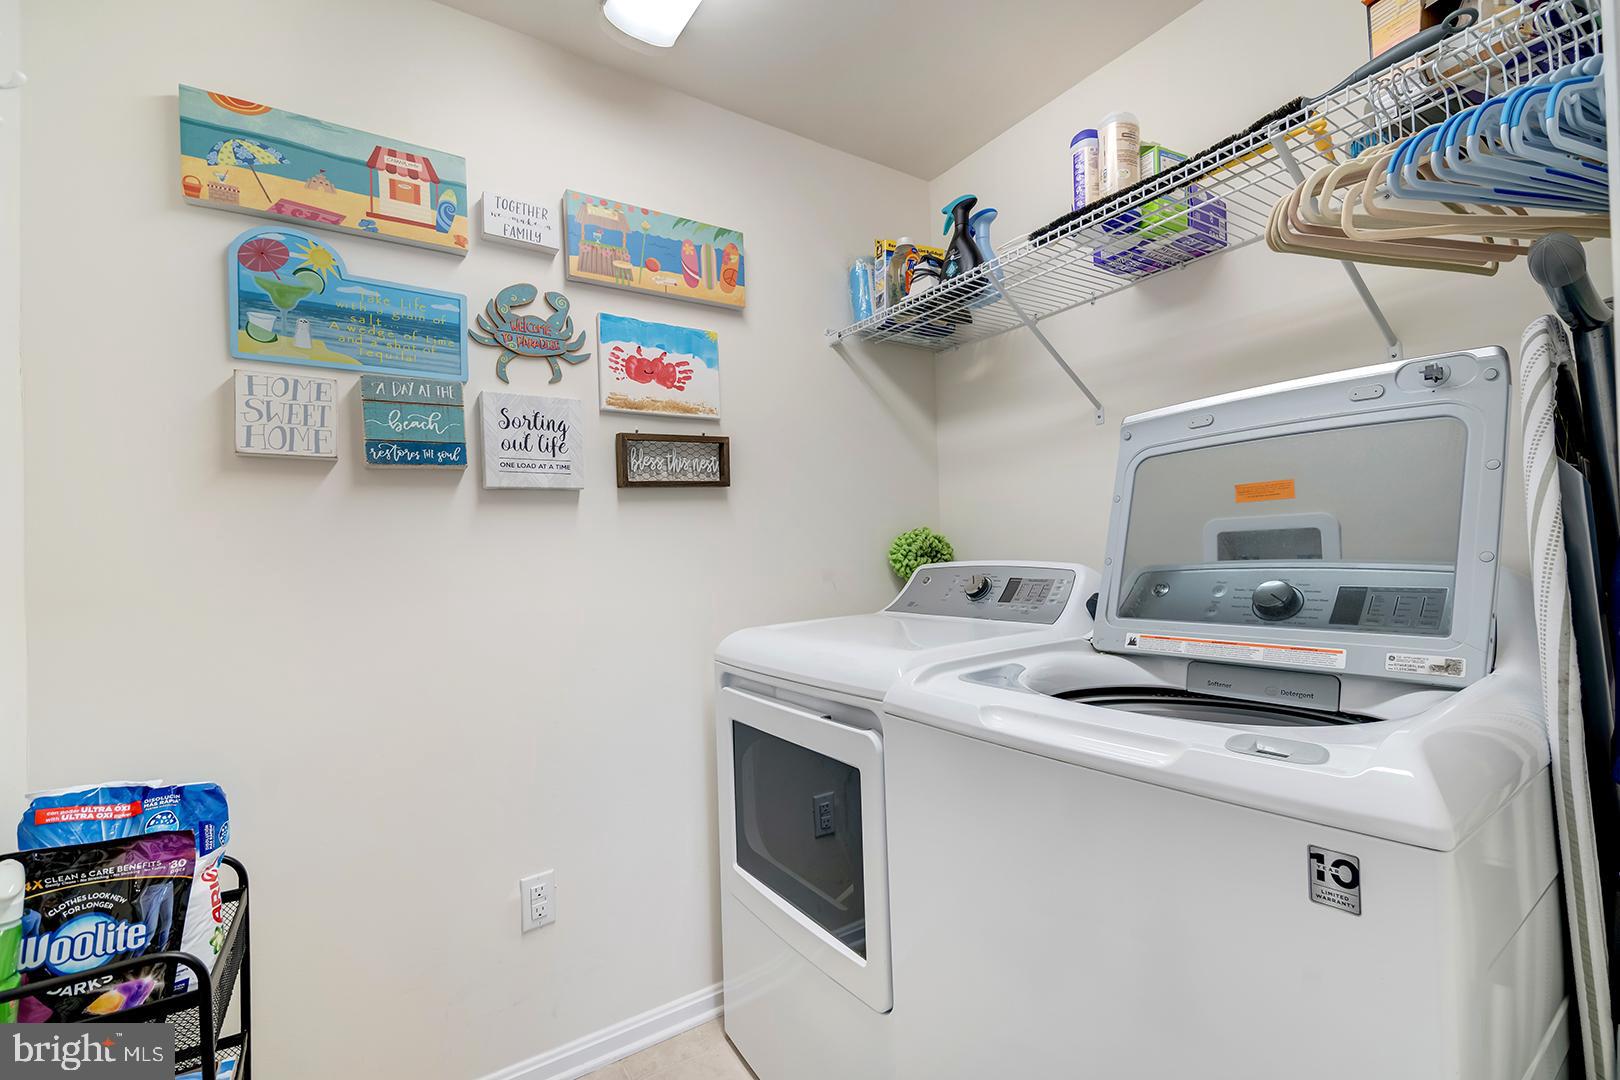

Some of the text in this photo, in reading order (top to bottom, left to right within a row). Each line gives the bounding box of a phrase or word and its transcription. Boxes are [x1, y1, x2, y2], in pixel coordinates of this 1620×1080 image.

[495, 196, 548, 220] TOGETHER
[503, 223, 542, 243] FAMILY
[432, 315, 447, 325] of
[510, 318, 552, 337] WELCOME
[330, 321, 339, 329] A
[347, 325, 395, 340] wedge
[403, 330, 418, 340] of
[338, 334, 363, 345] and
[386, 338, 417, 350] shot
[501, 331, 560, 351] TO PARADISE
[244, 375, 332, 403] HOME
[371, 382, 456, 399] A DAY AT THE
[240, 399, 333, 428] SWEET
[366, 409, 461, 434] beach
[498, 407, 570, 442] Sorting
[240, 424, 333, 455] HOME
[501, 431, 569, 458] out life
[369, 443, 461, 462] restores THE soul
[630, 447, 719, 473] bless this nest
[500, 461, 515, 469] ONE
[1207, 679, 1232, 689] Softener
[1280, 689, 1314, 700] Detergent
[81, 804, 112, 813] ULTRA
[172, 858, 187, 869] 30
[1310, 852, 1360, 889] 10
[26, 879, 43, 892] 4X
[44, 873, 79, 884] CLEAN
[88, 867, 115, 877] CARE
[117, 860, 162, 873] BENEFITS
[48, 892, 128, 917] CLOTHES LOOK NEW
[1315, 893, 1356, 909] WARRANTY
[1321, 889, 1350, 901] LIMITED
[63, 901, 114, 918] FOR LONGER
[17, 921, 147, 971] Woolite
